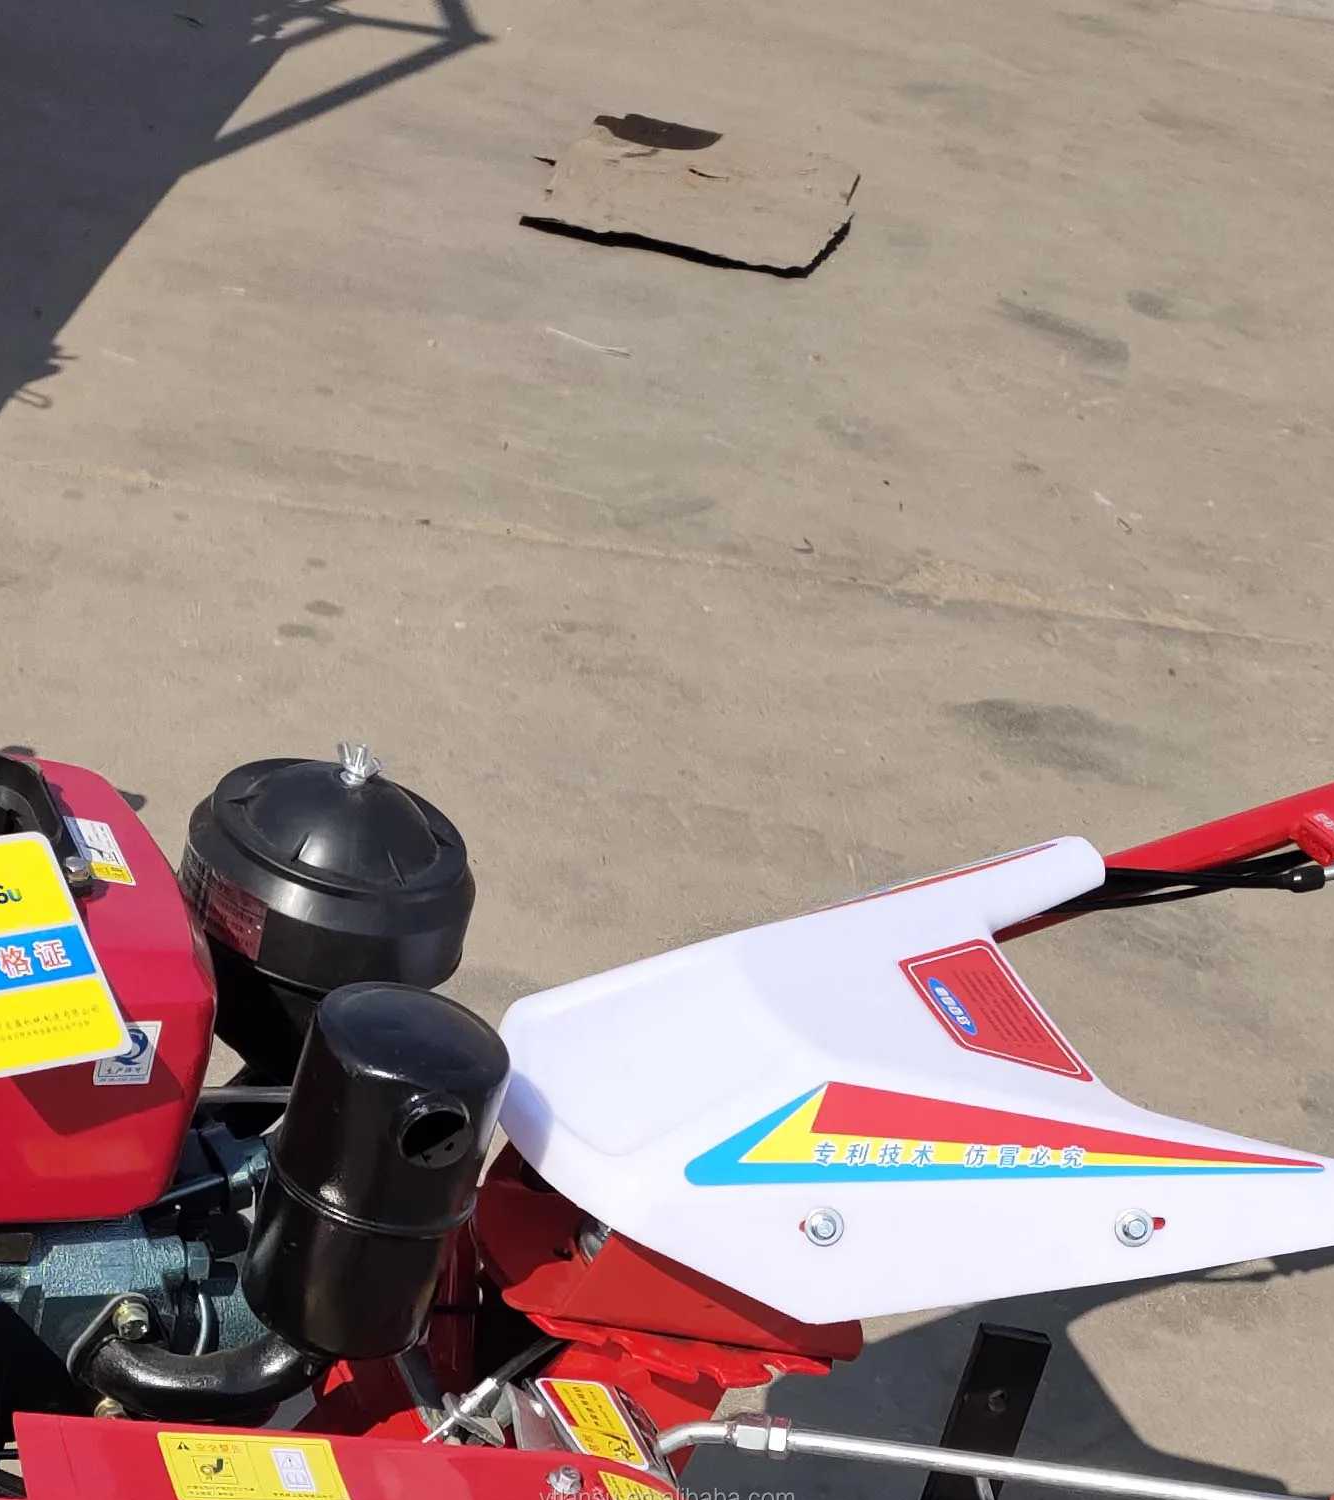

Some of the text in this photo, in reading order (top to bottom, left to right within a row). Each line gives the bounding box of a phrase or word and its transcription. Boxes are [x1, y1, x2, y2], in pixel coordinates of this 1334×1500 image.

[813, 1142, 1085, 1168] 专利技术 仿冒必究
